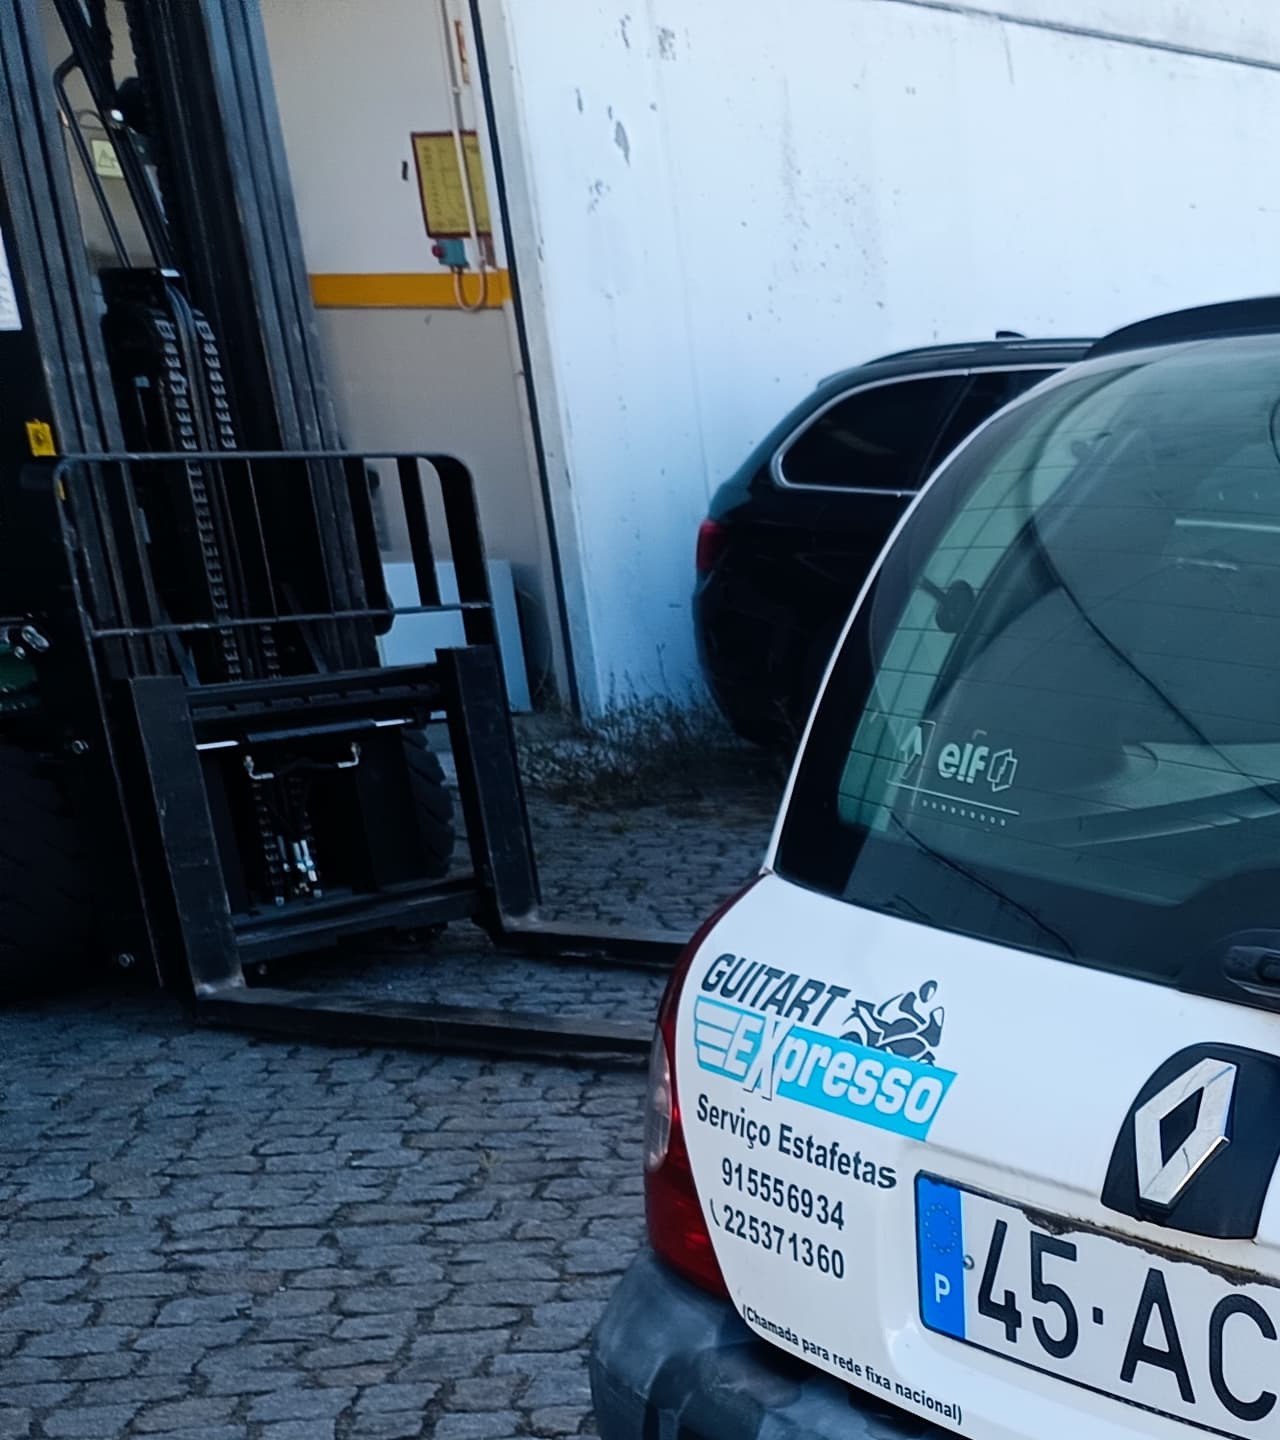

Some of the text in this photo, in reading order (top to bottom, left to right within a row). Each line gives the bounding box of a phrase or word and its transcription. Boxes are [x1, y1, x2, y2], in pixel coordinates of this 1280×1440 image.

[938, 743, 989, 784] elf
[701, 953, 851, 1027] GUITART
[697, 1093, 897, 1189] Serviço Estafetas
[722, 1157, 845, 1231] 915556934
[934, 1272, 951, 1303] P
[742, 1304, 963, 1426] (Chamada para rede fixa nacional)
